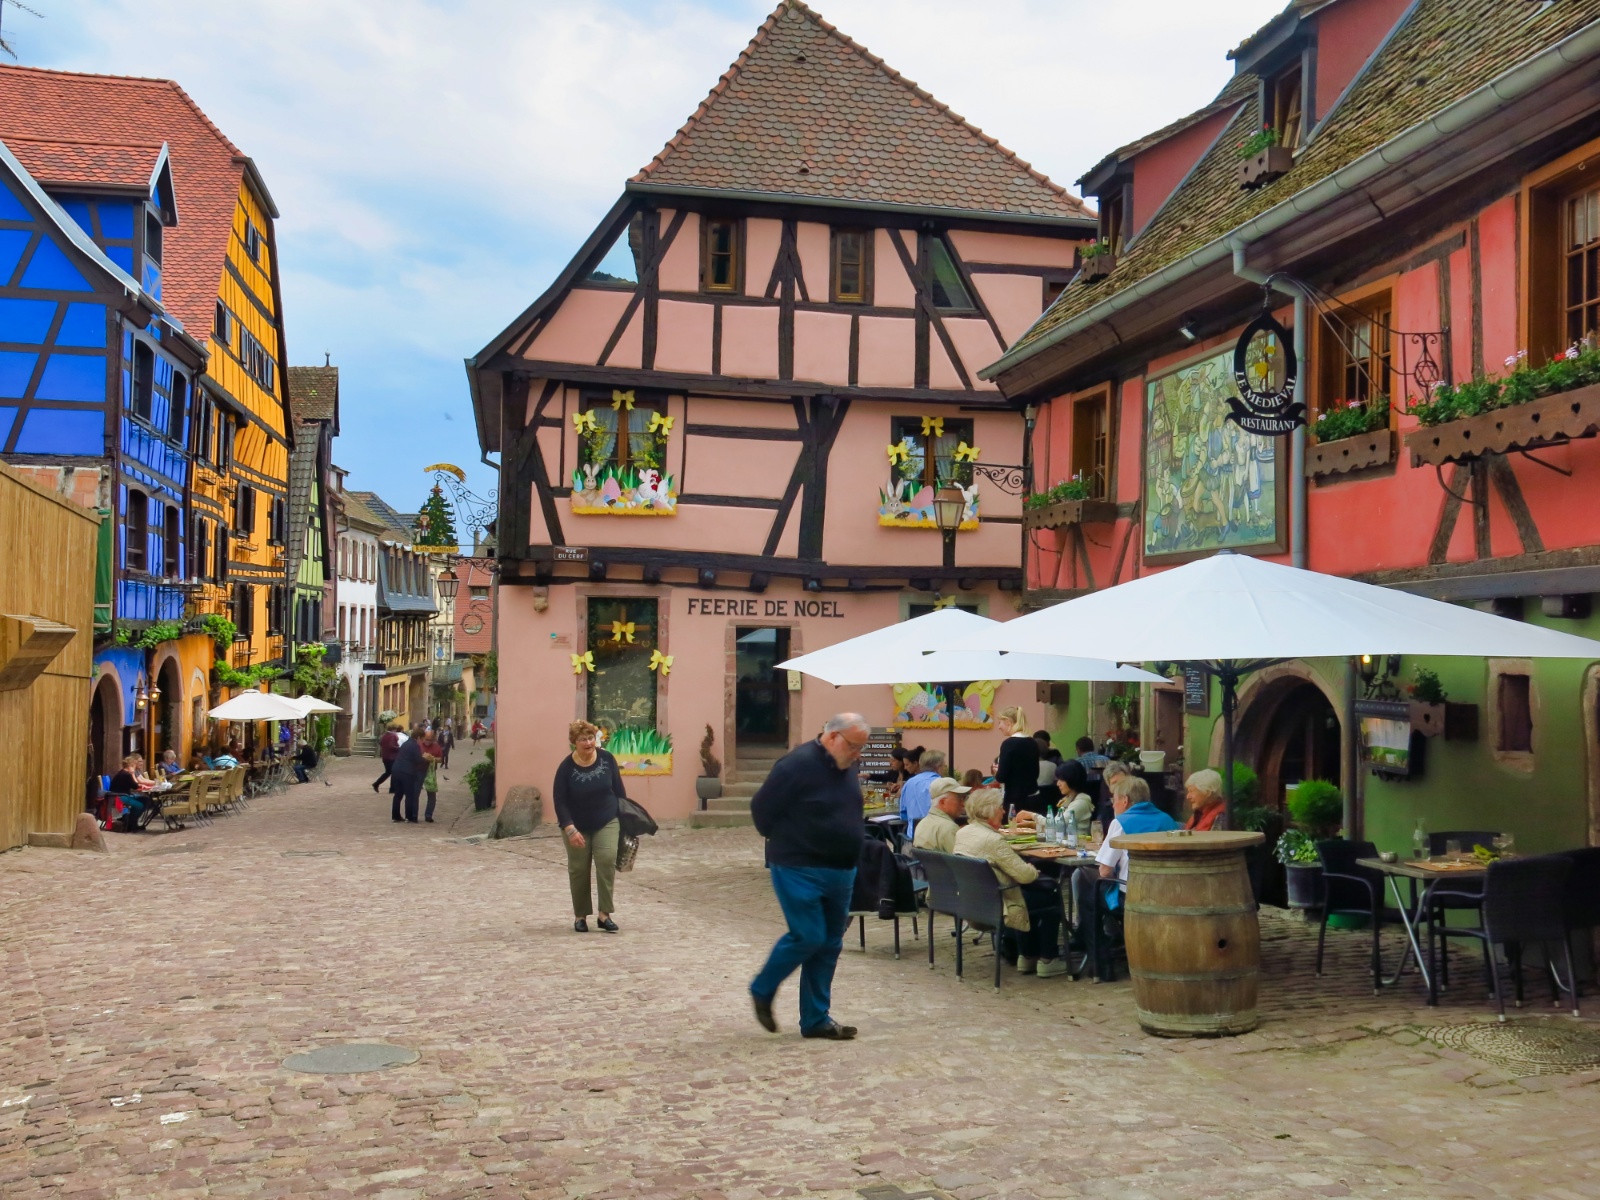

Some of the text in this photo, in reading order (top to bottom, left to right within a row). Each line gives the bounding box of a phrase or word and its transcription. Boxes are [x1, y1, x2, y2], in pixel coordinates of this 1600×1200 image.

[1236, 371, 1297, 407] LE MEDIEVAL
[1240, 417, 1296, 431] RESTAURANT
[687, 598, 845, 618] FEERIE DE NOEL
